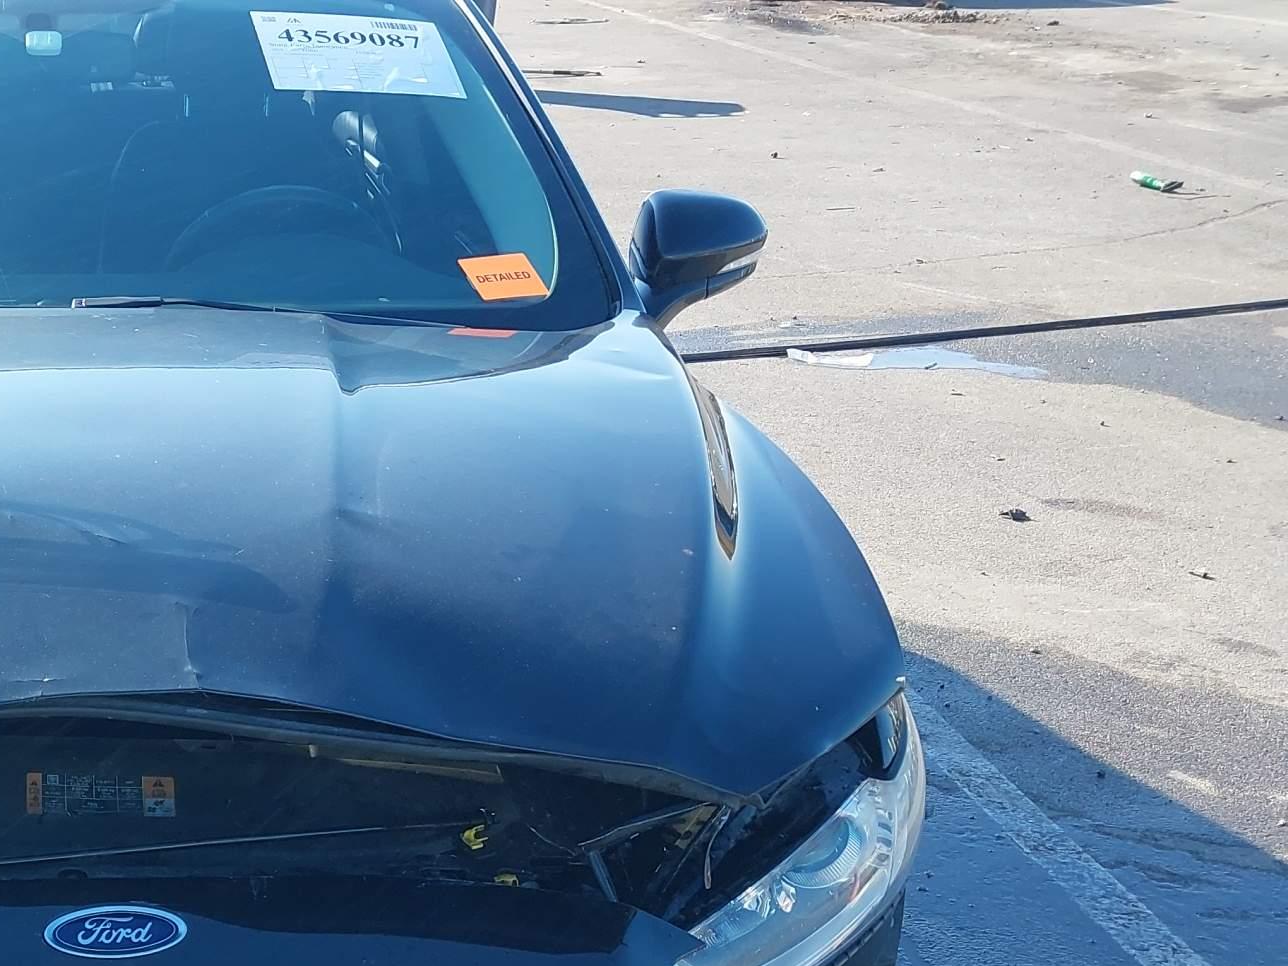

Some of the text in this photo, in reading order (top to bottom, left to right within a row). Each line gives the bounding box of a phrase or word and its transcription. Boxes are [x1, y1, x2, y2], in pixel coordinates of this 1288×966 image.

[277, 27, 420, 49] 43569087
[475, 271, 531, 284] DETAILED
[77, 916, 153, 945] Ford
